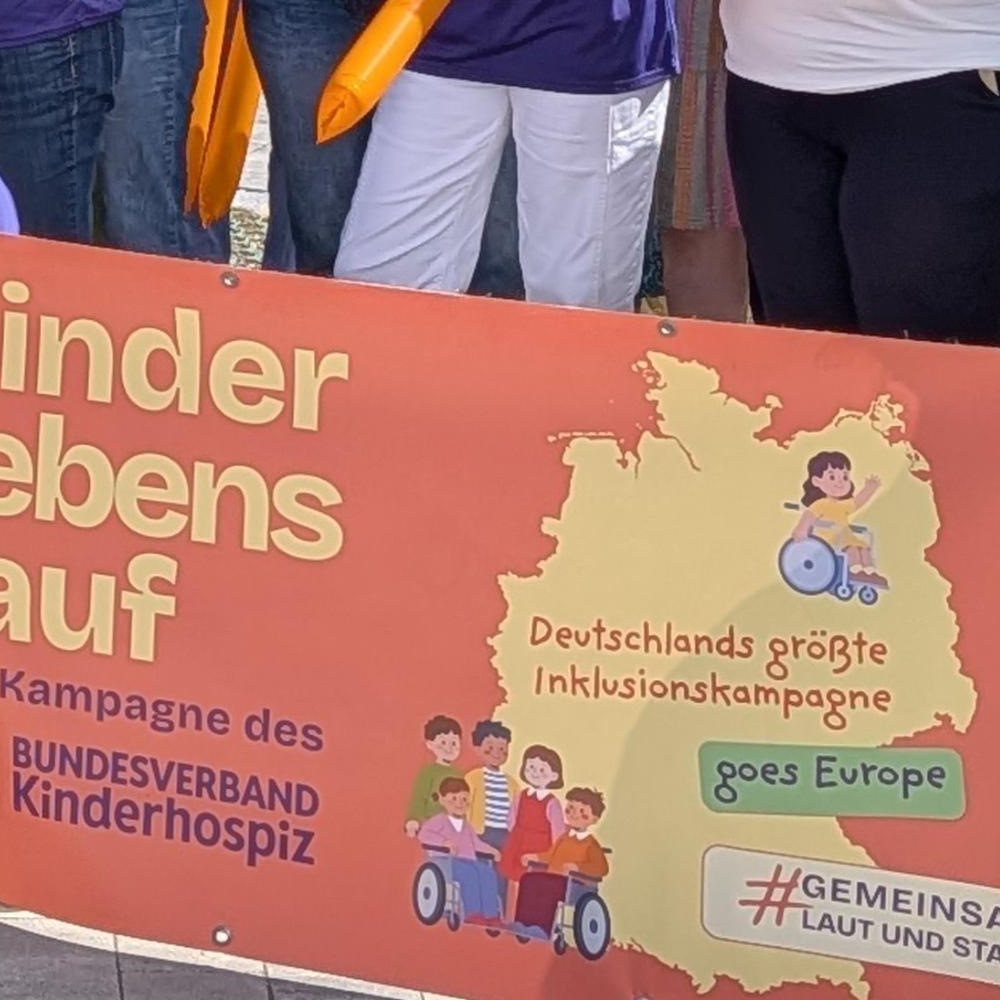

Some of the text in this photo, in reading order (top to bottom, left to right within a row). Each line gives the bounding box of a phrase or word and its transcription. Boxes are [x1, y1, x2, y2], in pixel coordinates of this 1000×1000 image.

[530, 616, 888, 680] Deutschlands größte
[0, 667, 231, 733] Kampagne
[244, 707, 324, 752] des
[534, 664, 892, 730] Inklusionskampagne
[12, 735, 320, 818] BUNDESVERBAND
[714, 755, 946, 803] goes Europe
[12, 771, 316, 867] Kinderhospiz
[802, 909, 875, 940] LAUT
[881, 922, 945, 951] UND
